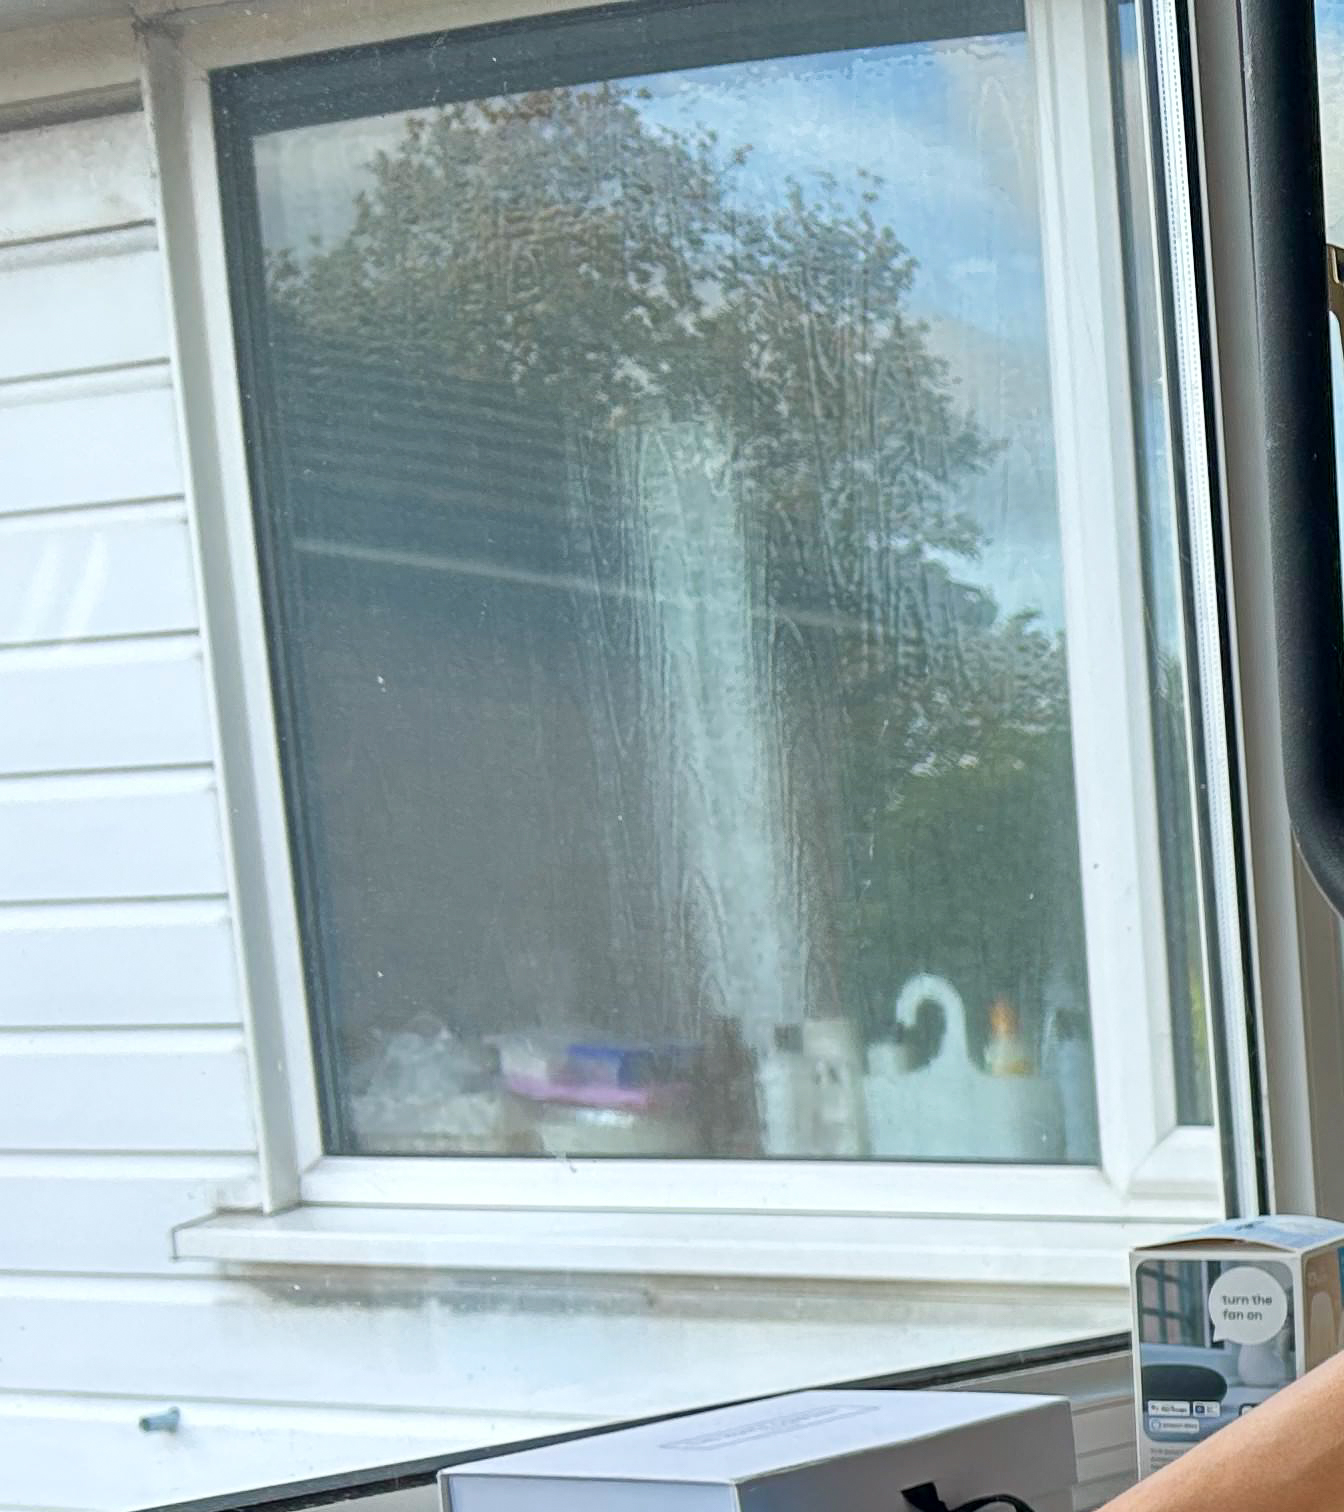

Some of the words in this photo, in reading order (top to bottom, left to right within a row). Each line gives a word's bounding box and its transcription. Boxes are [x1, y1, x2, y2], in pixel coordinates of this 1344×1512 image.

[1222, 1294, 1249, 1306] turn
[1252, 1294, 1273, 1305] the
[1222, 1309, 1243, 1321] fan
[1246, 1311, 1262, 1321] on
